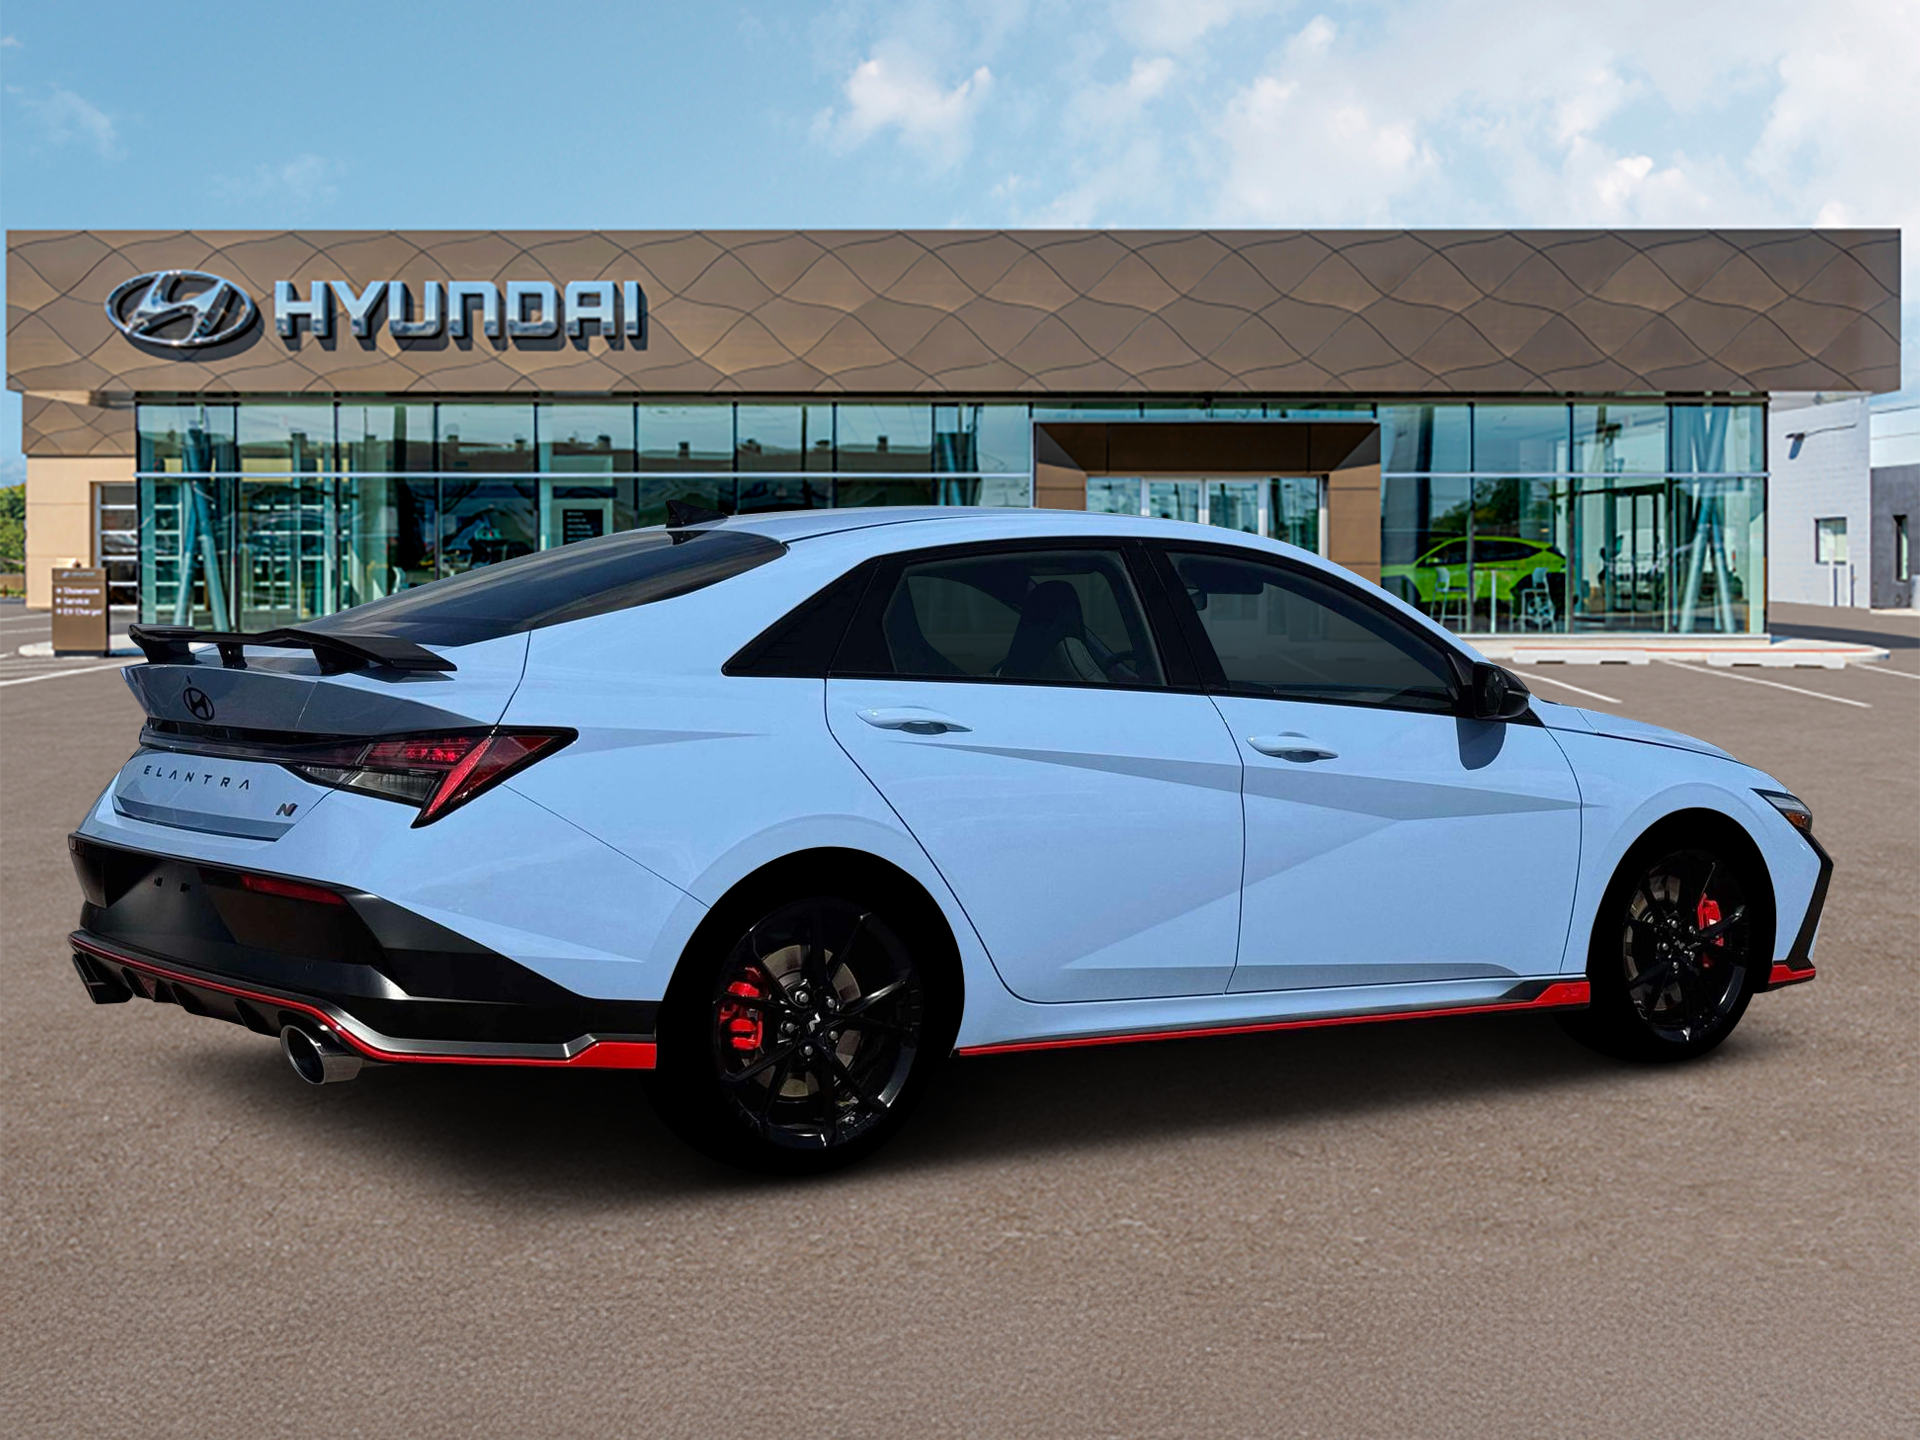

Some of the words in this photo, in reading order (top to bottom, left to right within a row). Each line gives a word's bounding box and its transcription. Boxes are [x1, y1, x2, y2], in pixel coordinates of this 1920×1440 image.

[274, 280, 641, 339] HYUNDAI
[143, 765, 250, 790] ELANTRA
[275, 803, 298, 817] N
